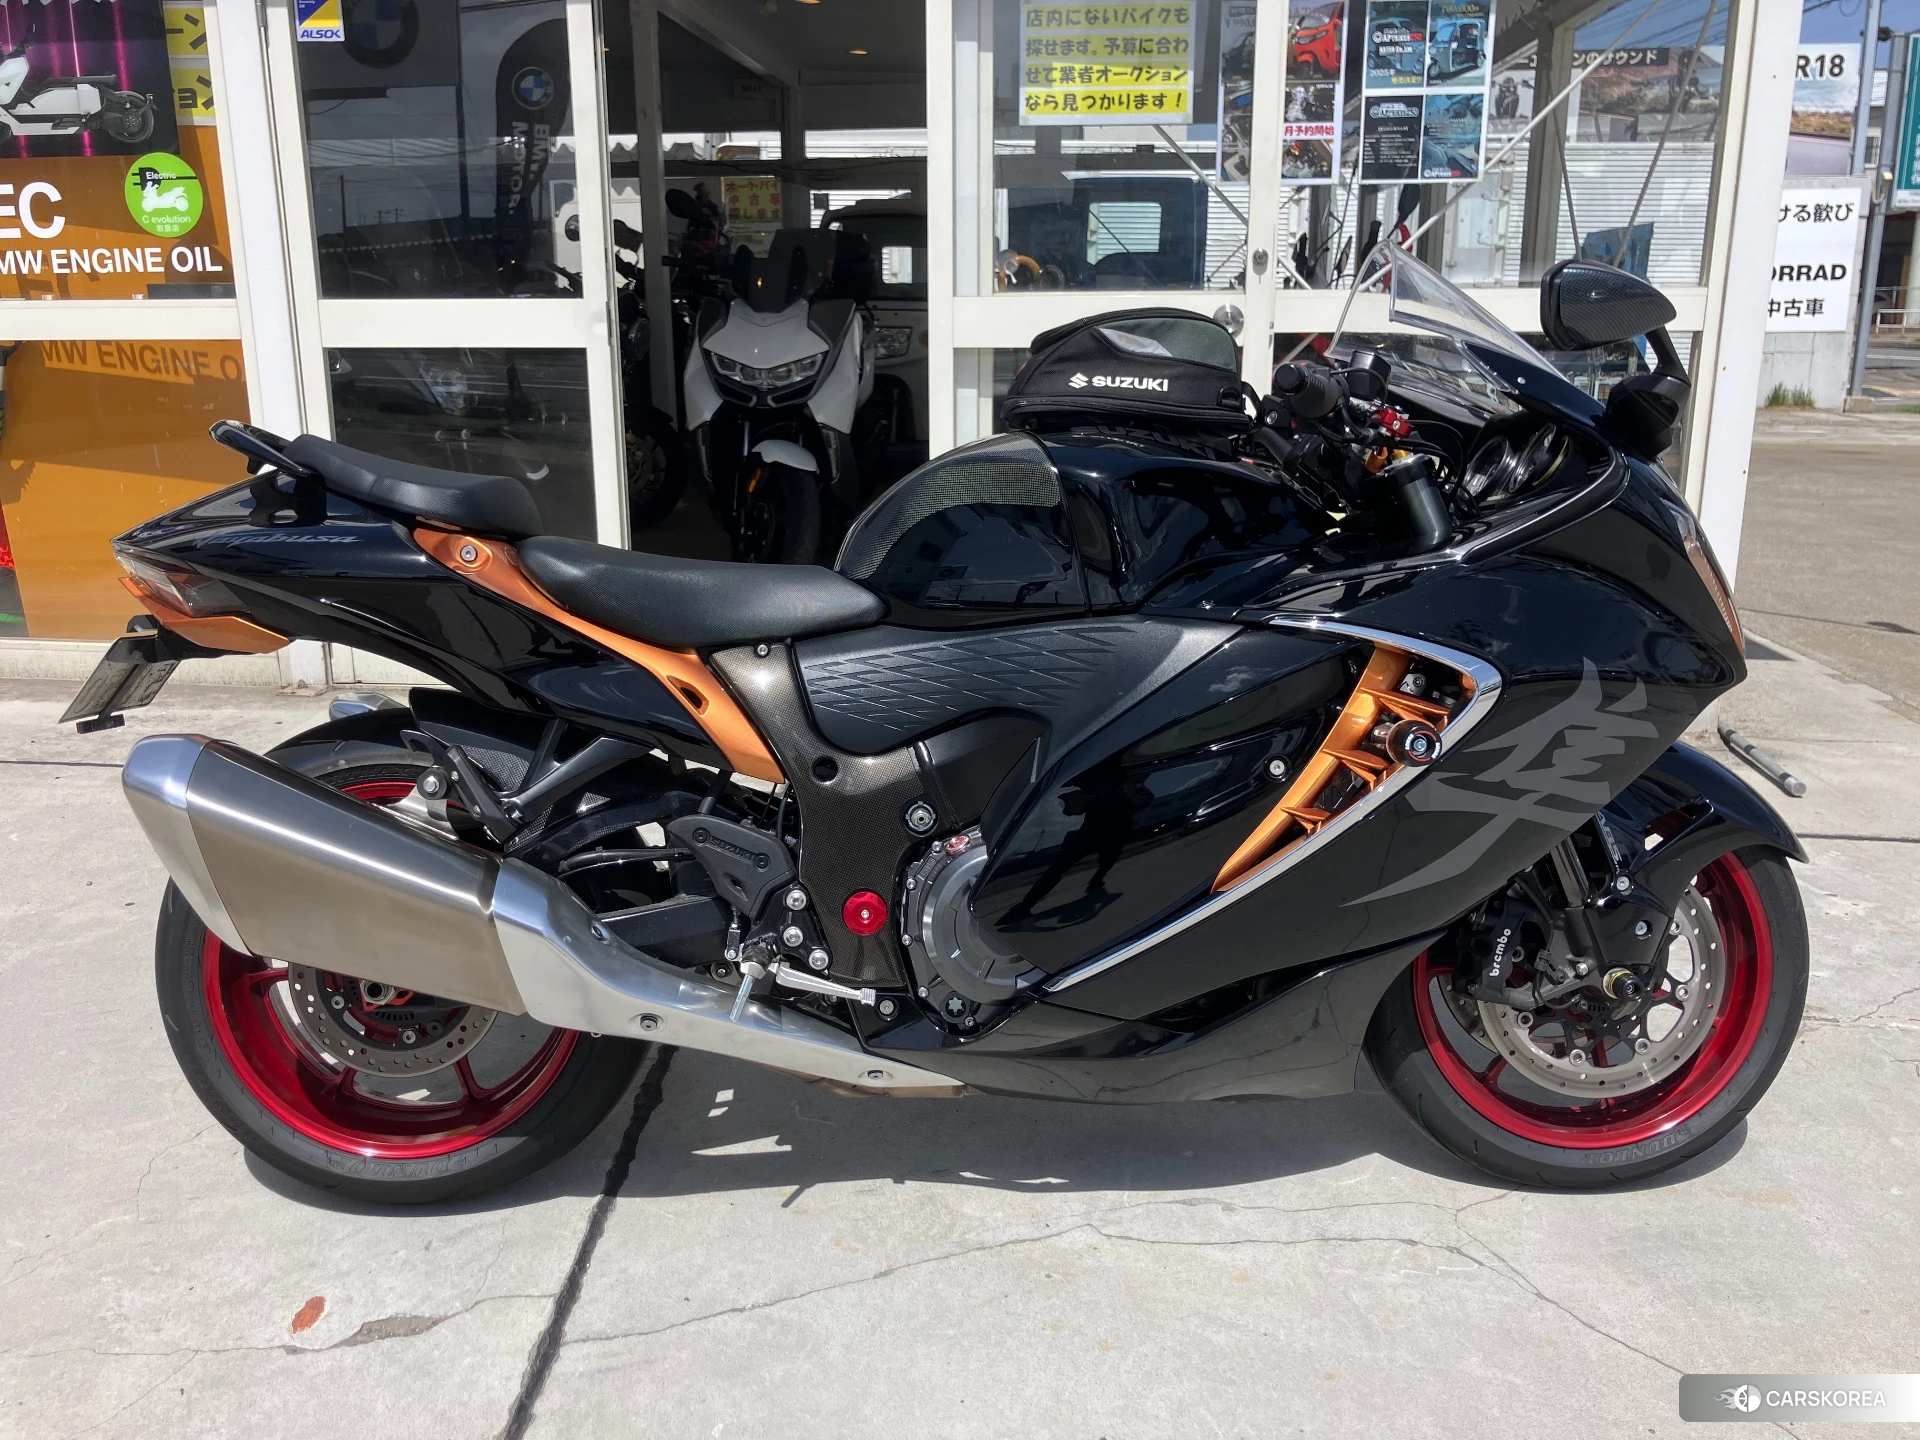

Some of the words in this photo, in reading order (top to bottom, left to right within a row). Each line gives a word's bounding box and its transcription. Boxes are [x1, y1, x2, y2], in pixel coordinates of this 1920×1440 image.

[1026, 7, 1189, 27] 店内にないバイクも
[300, 29, 341, 39] ALSOK
[1026, 36, 1189, 58] 探せます。予算に合わ
[1026, 64, 1188, 84] せて業者オークション
[1795, 54, 1845, 78] R18
[1025, 92, 1182, 112] なら見つかります！
[146, 171, 177, 180] Electric
[142, 214, 150, 224] C
[151, 214, 191, 224] evolution
[0, 249, 43, 275] MW
[50, 247, 165, 274] ENGINE
[171, 246, 223, 273] OIL
[1771, 264, 1847, 282] RRAD
[1768, 298, 1825, 318] 中古車
[1091, 375, 1169, 392] SUZUKI
[1488, 928, 1512, 977] brembo
[1580, 1132, 1678, 1165] DUNLOP
